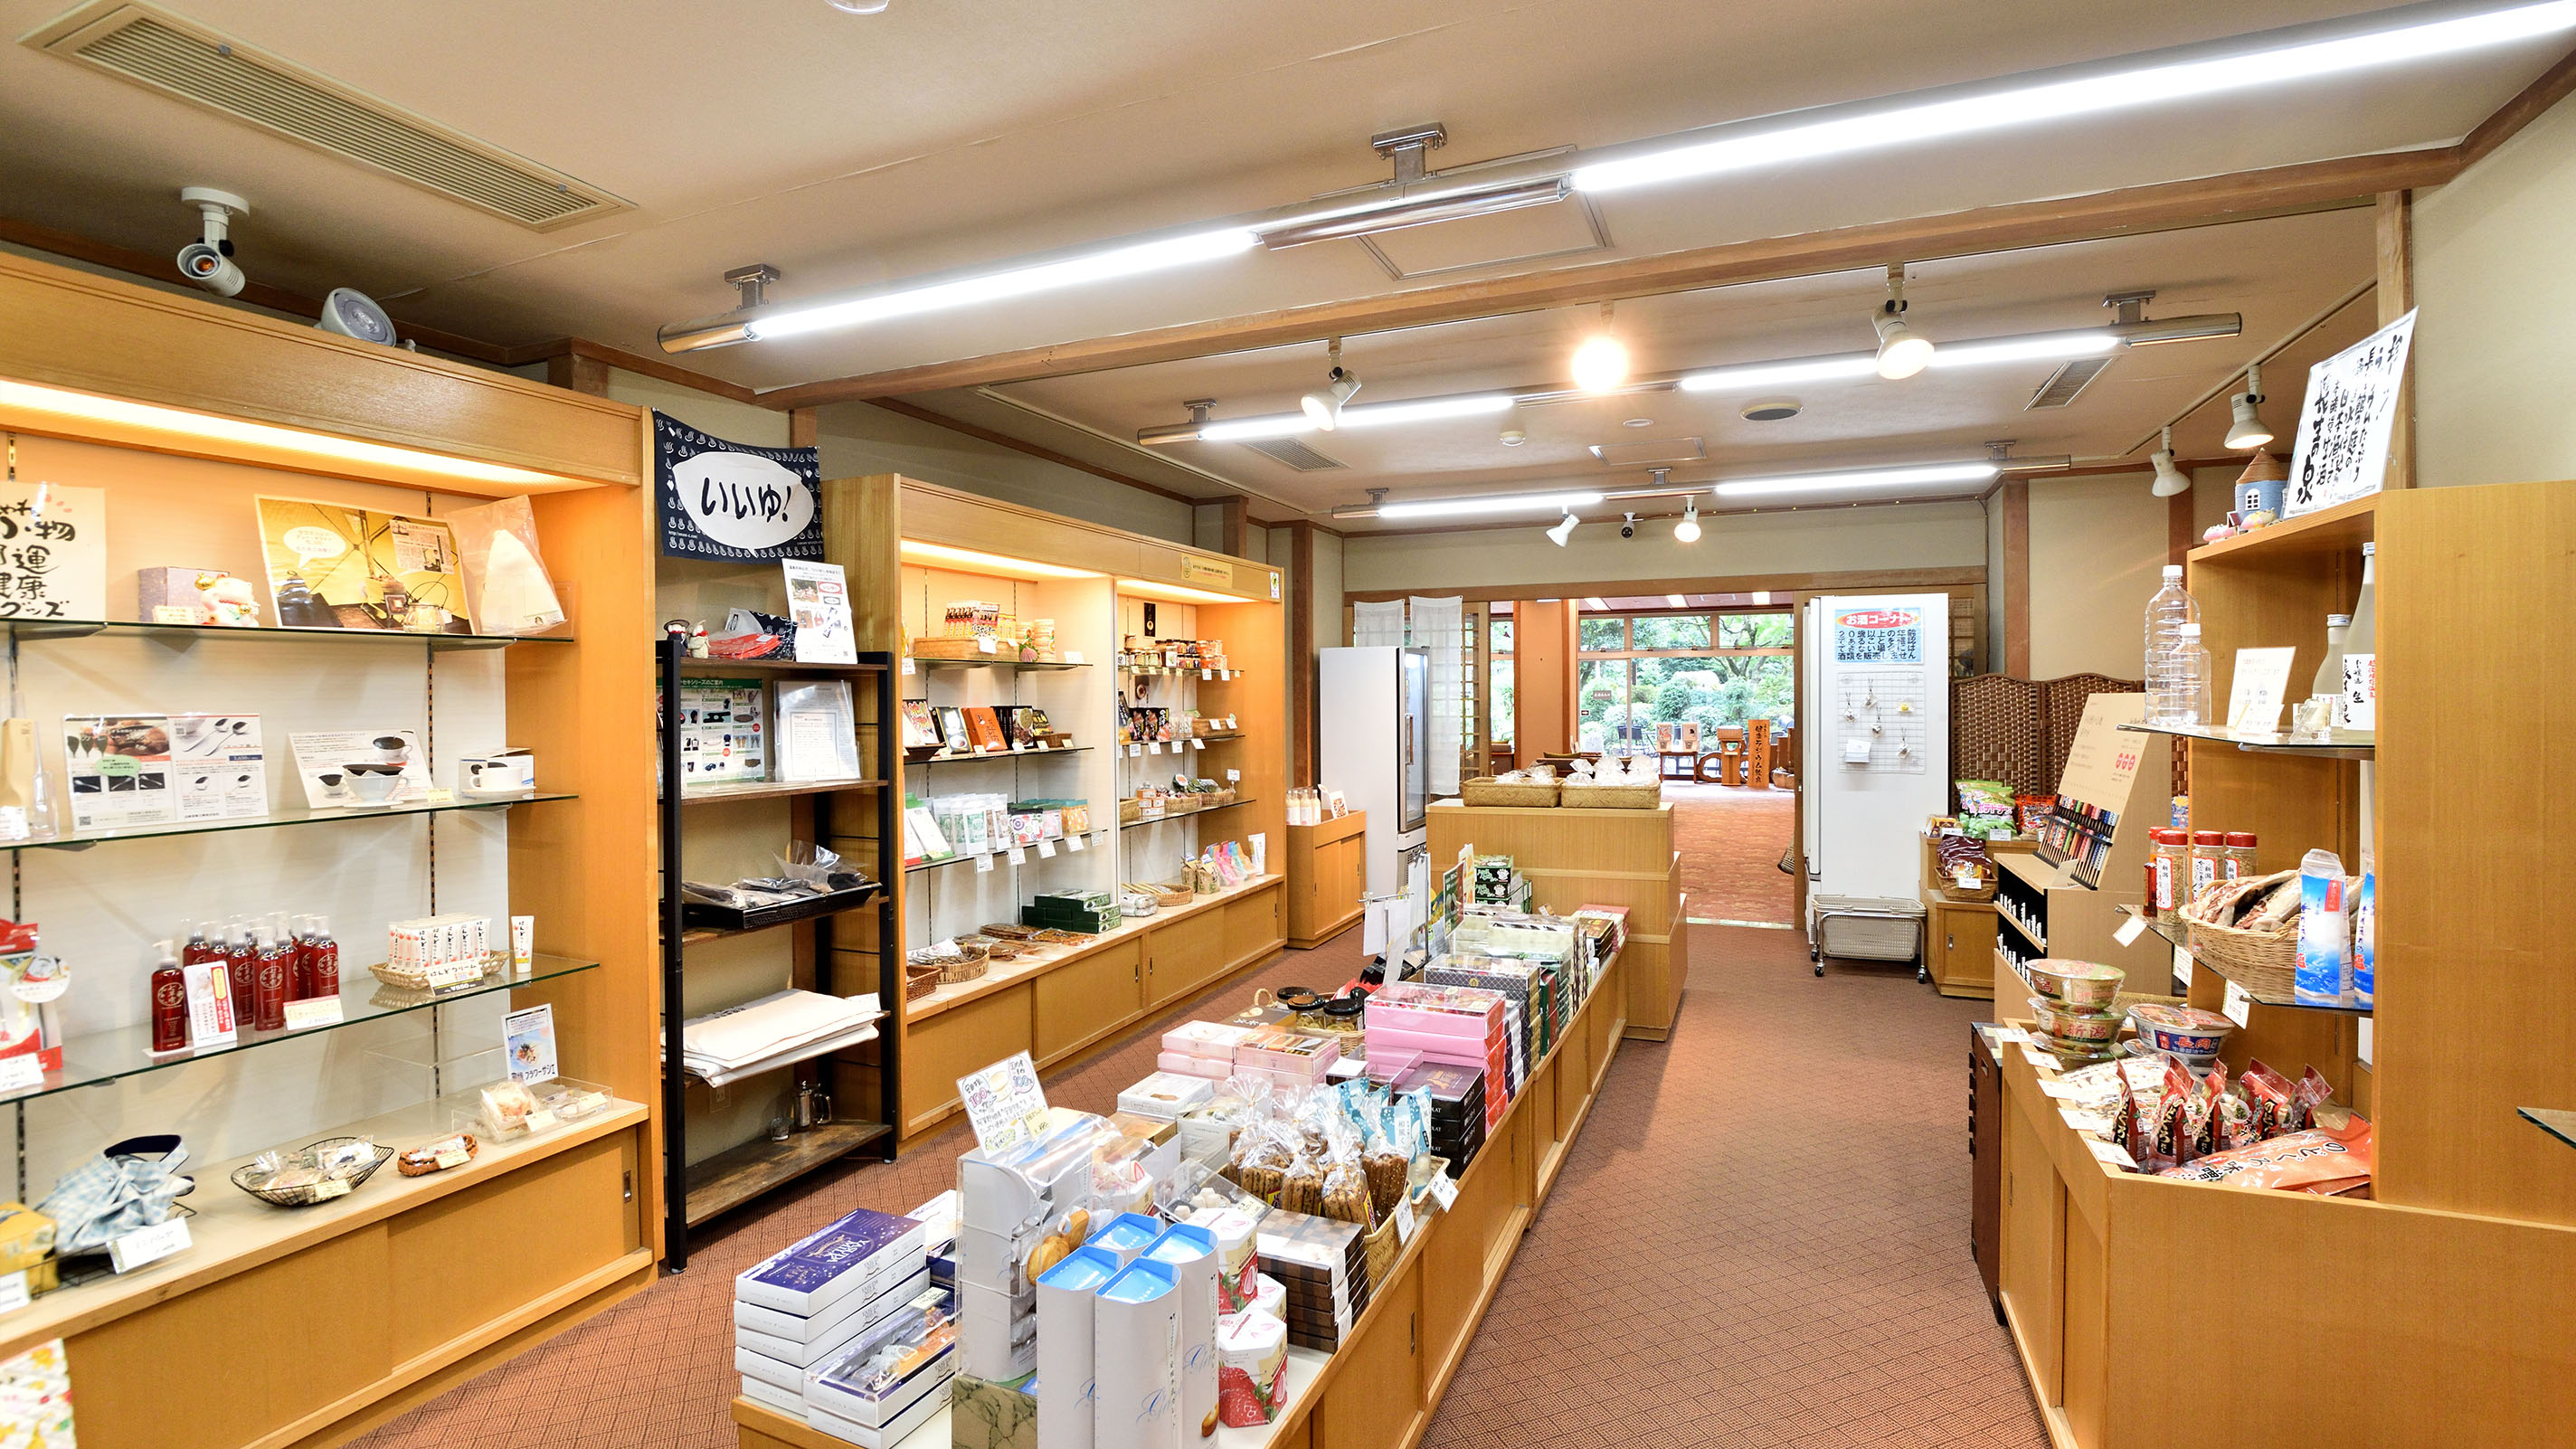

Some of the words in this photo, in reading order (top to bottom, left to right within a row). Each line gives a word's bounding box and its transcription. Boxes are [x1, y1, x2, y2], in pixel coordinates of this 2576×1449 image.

[701, 477, 791, 523] いいゆ!
[2067, 1023, 2107, 1038] 新潟
